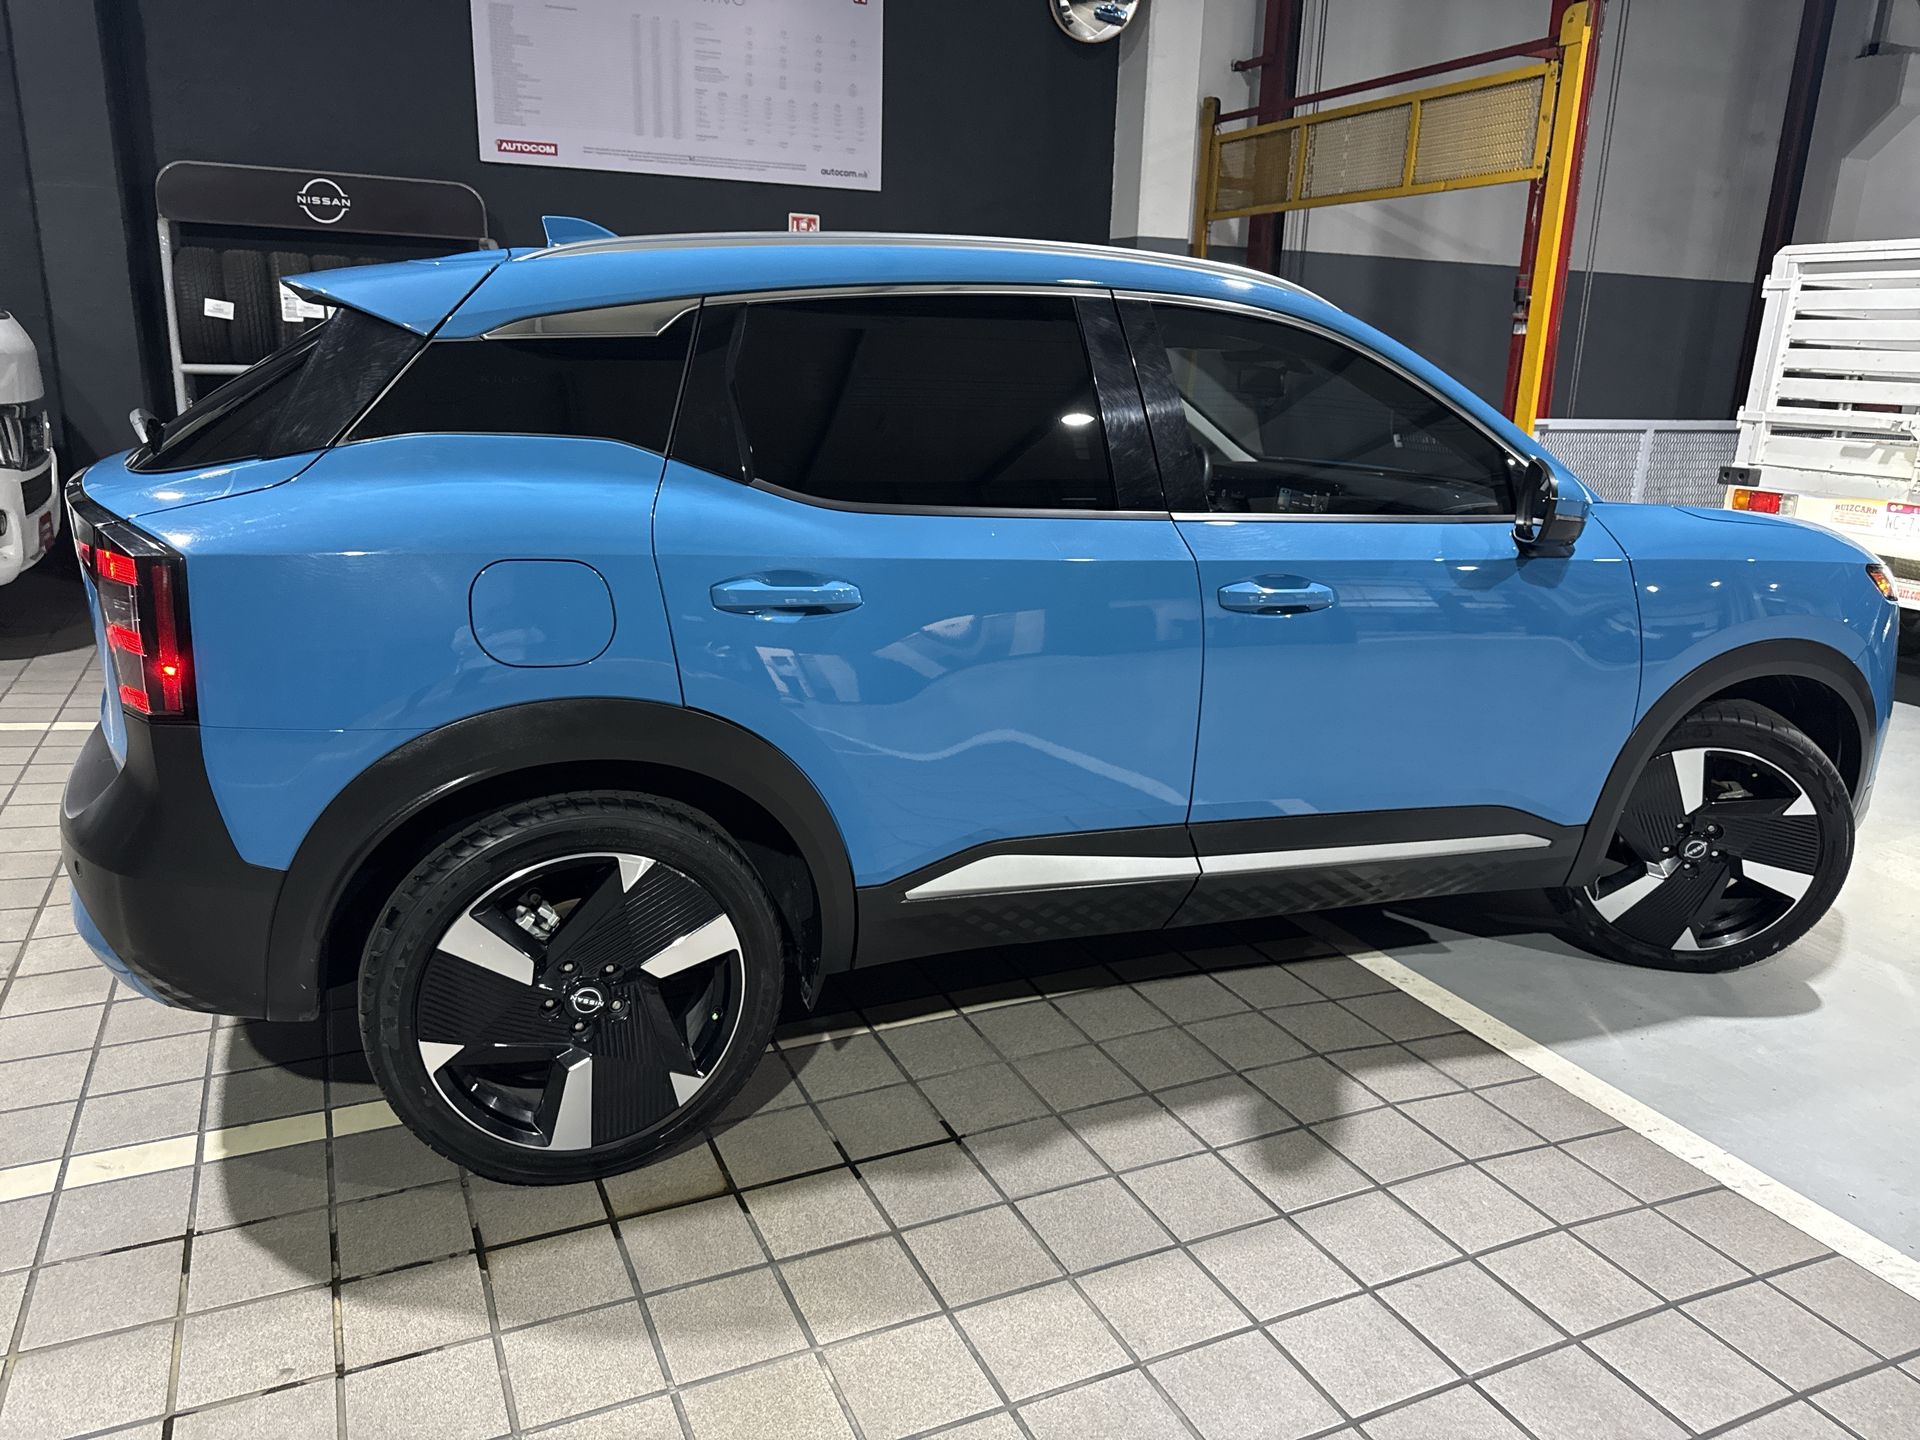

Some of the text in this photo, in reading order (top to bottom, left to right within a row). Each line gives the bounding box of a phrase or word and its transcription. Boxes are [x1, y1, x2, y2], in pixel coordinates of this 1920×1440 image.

[501, 142, 556, 154] AUTOCOM
[296, 195, 351, 207] NISSAN
[569, 994, 605, 1007] NISSAN
